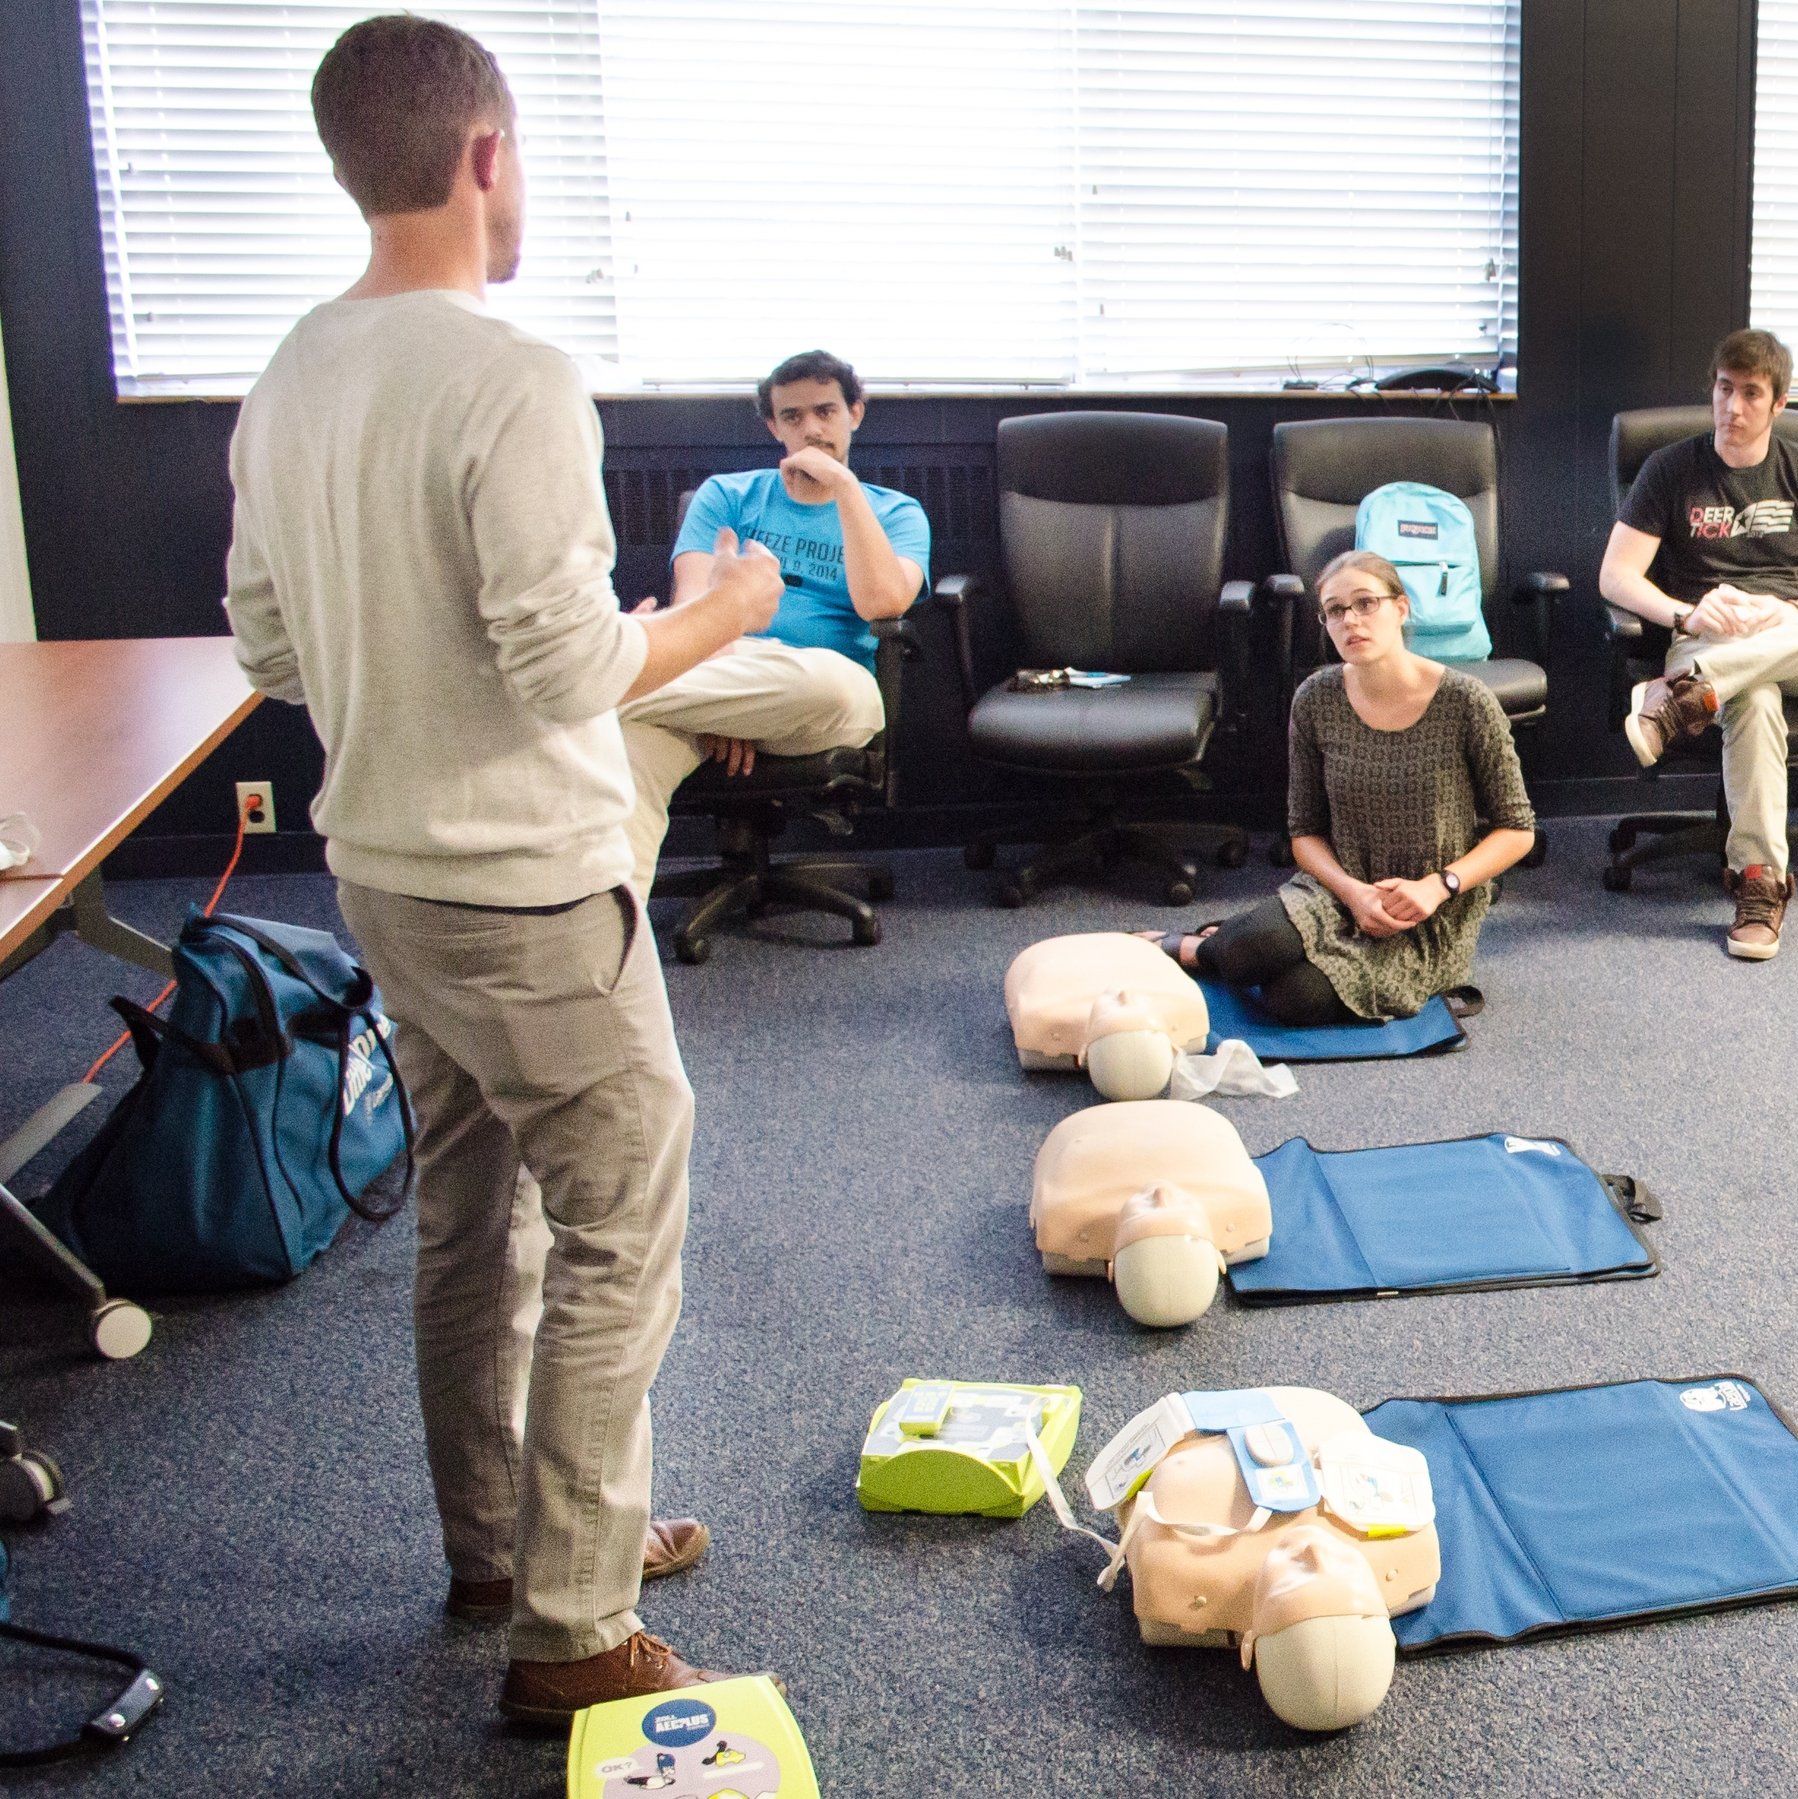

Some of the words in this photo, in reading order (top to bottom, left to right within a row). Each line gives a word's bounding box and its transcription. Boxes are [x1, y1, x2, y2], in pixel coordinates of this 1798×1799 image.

[1689, 506, 1735, 524] DEER
[1690, 523, 1732, 538] TICK
[795, 537, 845, 564] PROJE
[808, 562, 838, 581] 2014
[601, 1761, 633, 1773] OK?
